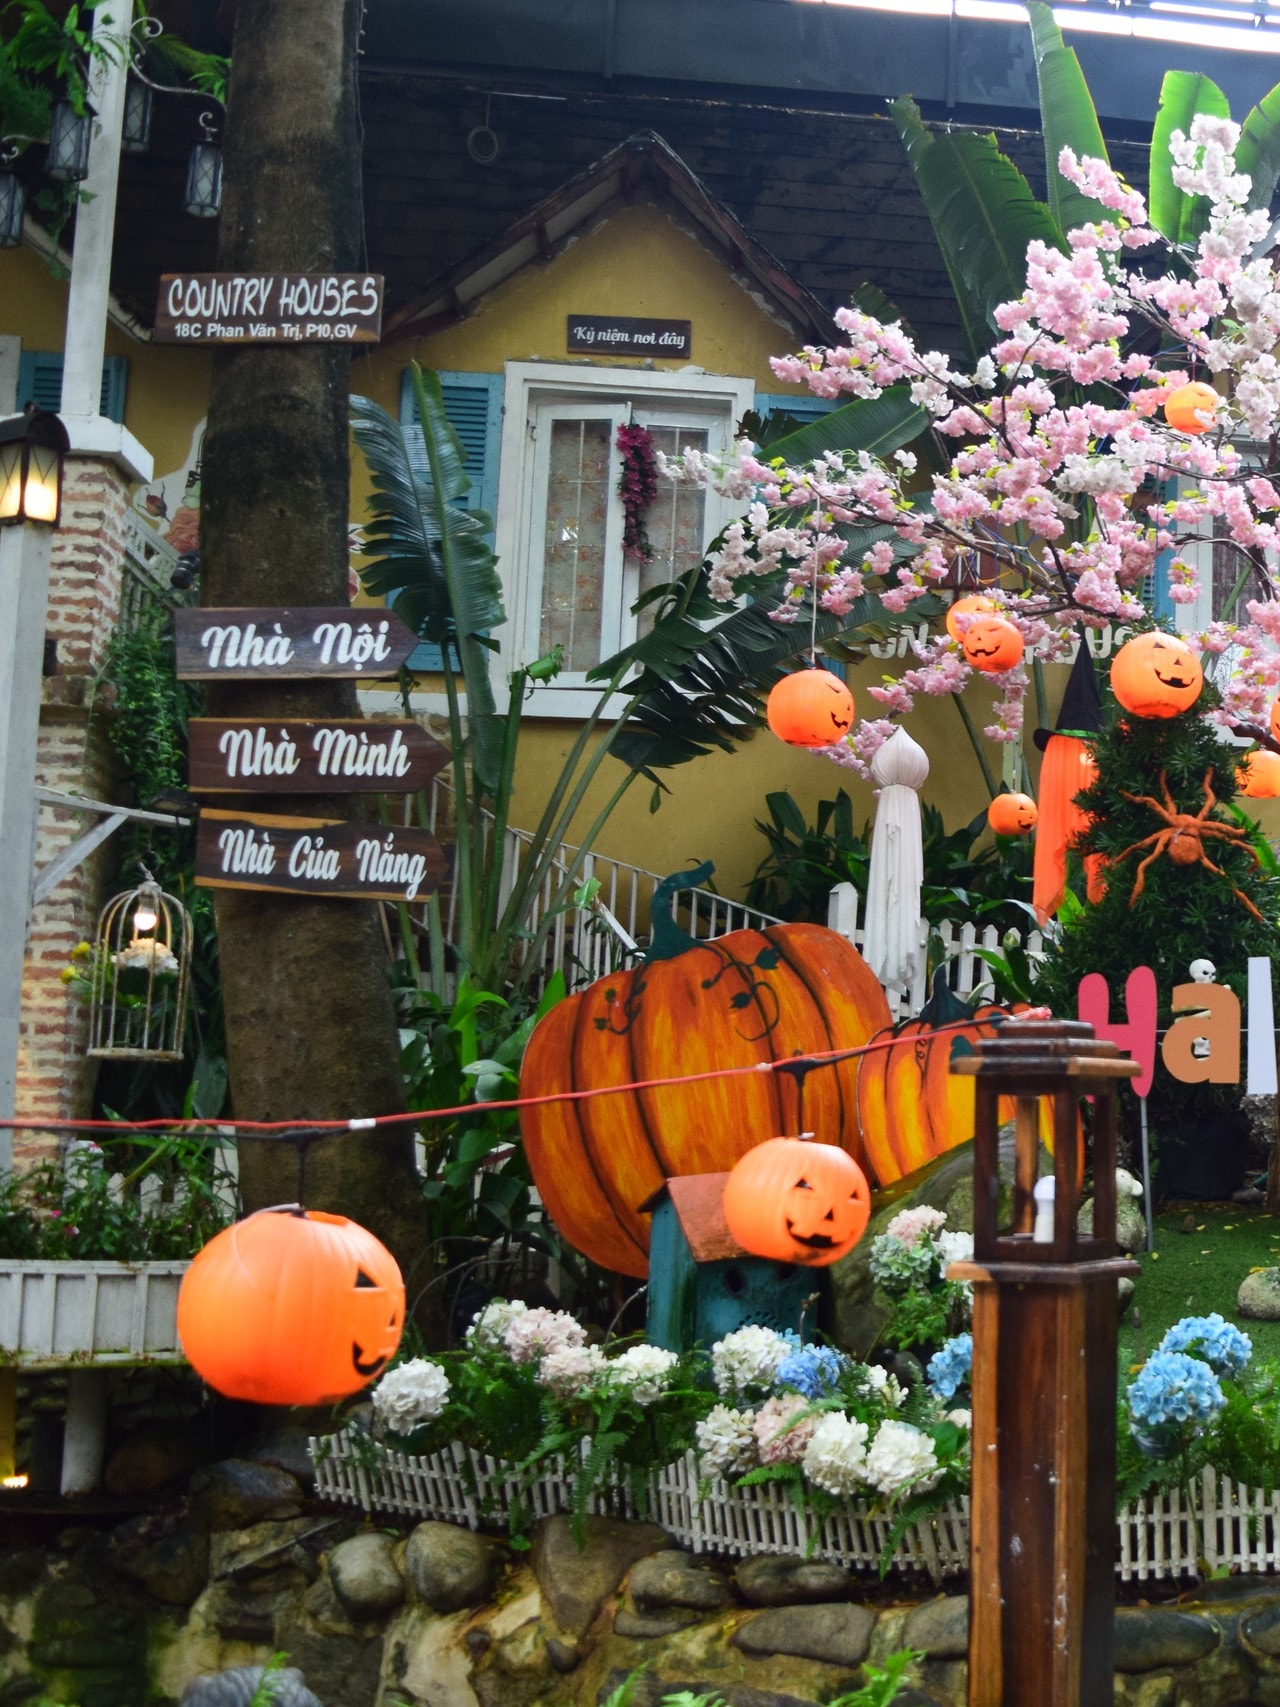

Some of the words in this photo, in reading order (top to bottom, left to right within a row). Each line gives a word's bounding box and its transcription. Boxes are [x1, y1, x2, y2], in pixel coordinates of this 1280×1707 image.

[168, 276, 274, 320] COUNTRY
[279, 276, 379, 317] HOUSES
[174, 323, 202, 338] 18C
[206, 323, 244, 338] Phan
[249, 323, 276, 338] Văn
[573, 326, 596, 344] Kỷ
[597, 328, 631, 345] niệm
[658, 331, 686, 349] đây
[201, 622, 296, 668] Nhà
[313, 620, 391, 671] Nội
[219, 727, 301, 777] Nhà
[313, 728, 412, 777] Mình
[218, 828, 276, 875] Nhà
[288, 835, 342, 880] Của
[355, 832, 428, 900] Nắng
